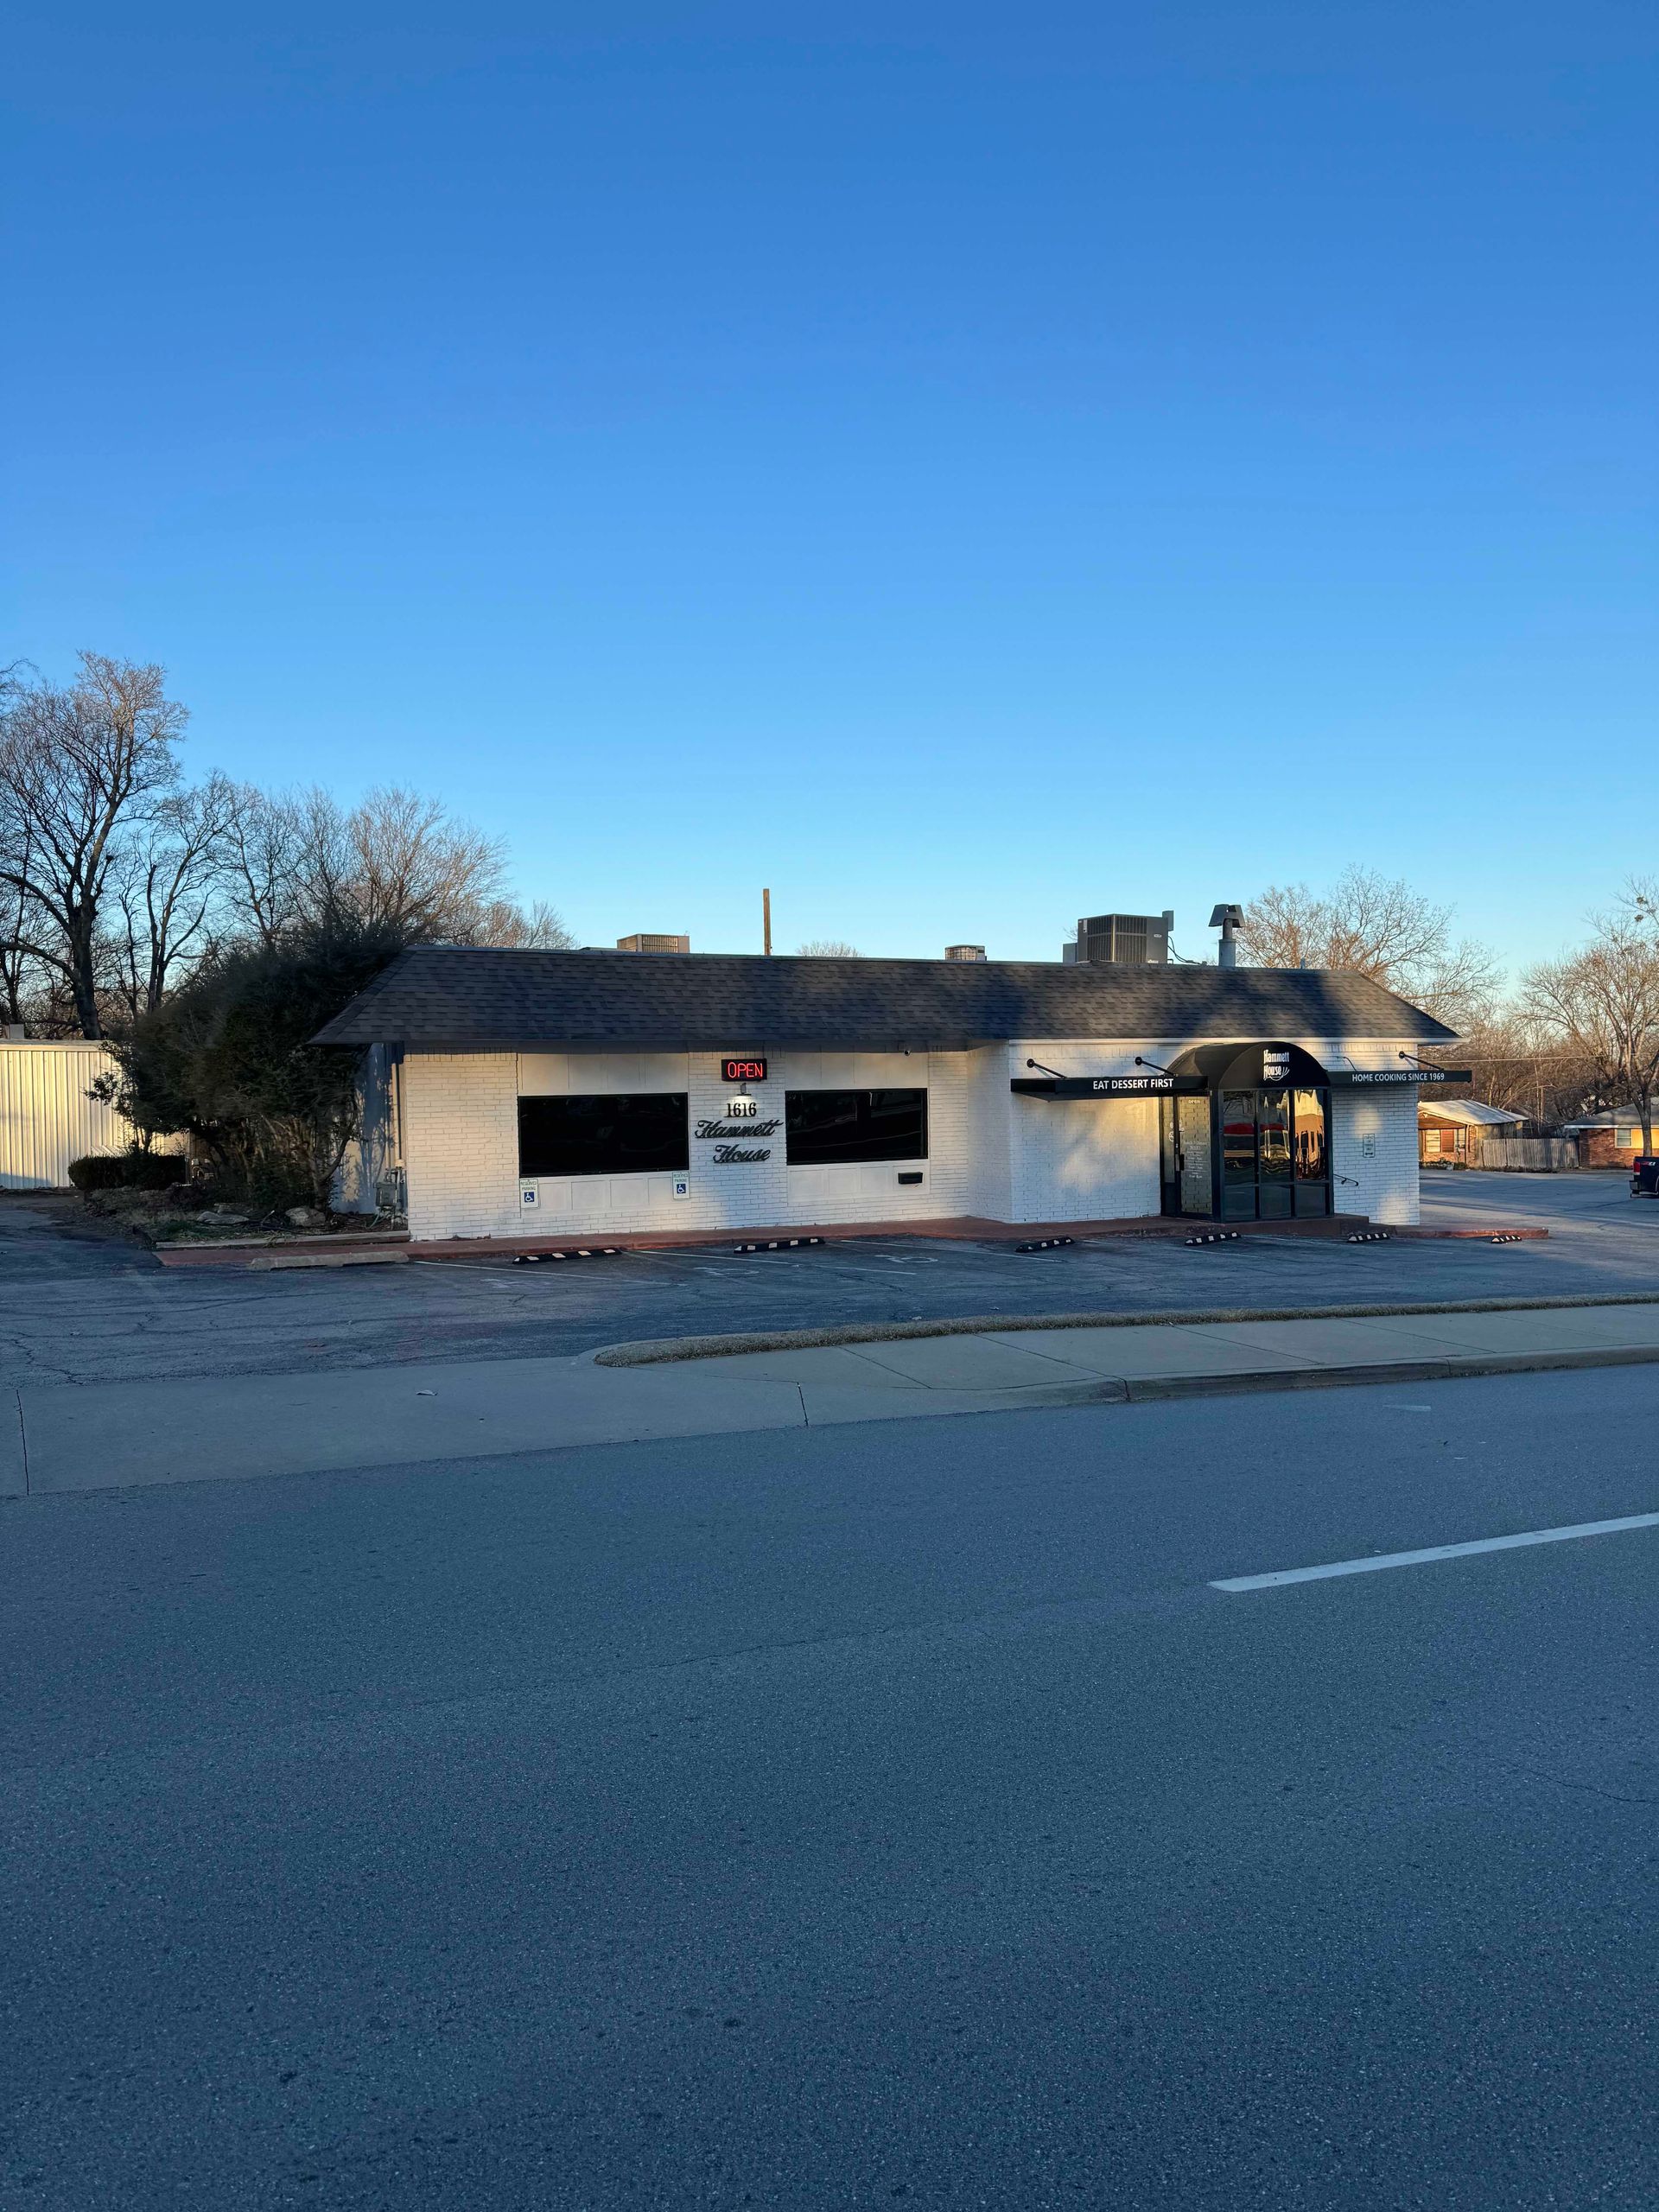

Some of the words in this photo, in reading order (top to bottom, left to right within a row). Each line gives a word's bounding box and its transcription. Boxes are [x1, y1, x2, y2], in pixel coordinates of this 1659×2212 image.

[1263, 1049, 1290, 1064] Hammett
[728, 1062, 763, 1078] OPEN
[1263, 1065, 1282, 1081] House
[1374, 1073, 1407, 1082] COOKING
[1408, 1072, 1427, 1081] SINCE
[1429, 1072, 1445, 1081] 1969
[1093, 1080, 1109, 1090] EAT
[1111, 1079, 1148, 1089] DESSERT
[1150, 1078, 1174, 1088] FIRST
[725, 1103, 757, 1117] 1616
[695, 1120, 784, 1138] Hammett
[713, 1144, 771, 1163] House
